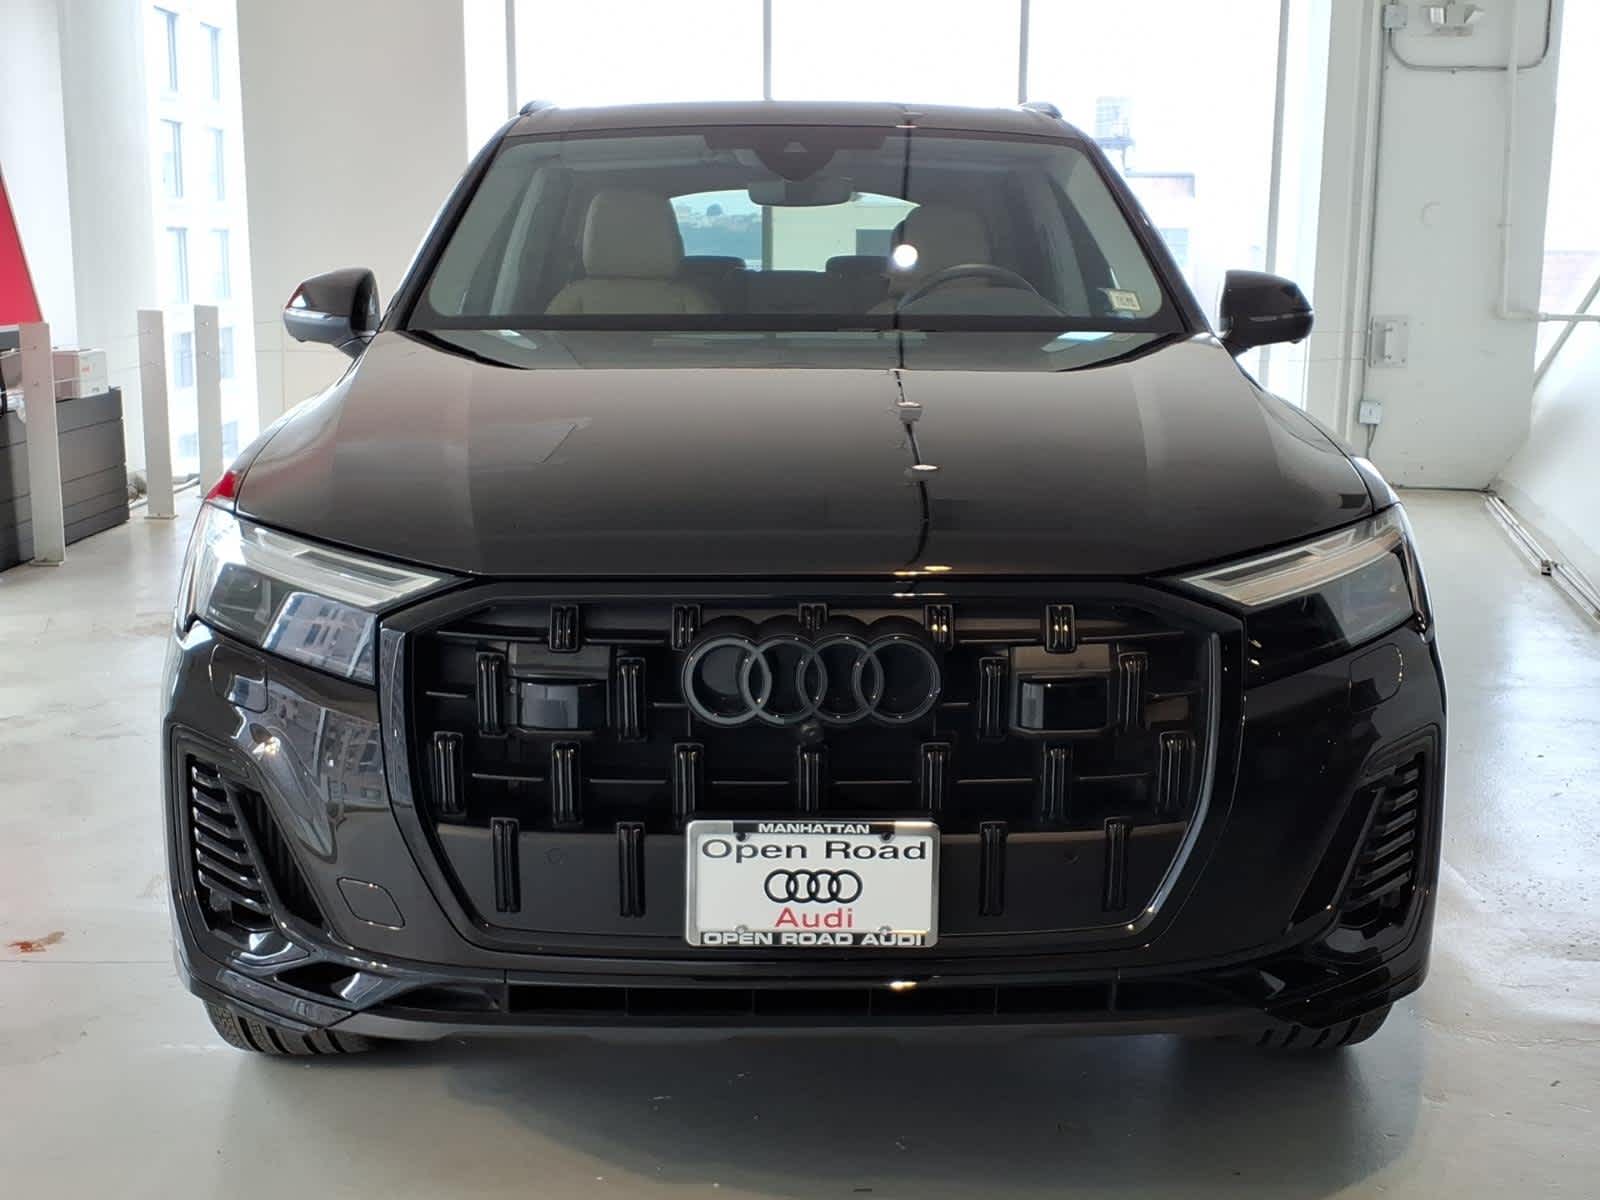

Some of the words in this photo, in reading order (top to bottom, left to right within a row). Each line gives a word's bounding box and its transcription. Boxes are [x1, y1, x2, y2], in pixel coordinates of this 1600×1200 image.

[758, 823, 870, 834] MANHATTAN
[702, 839, 808, 863] Open
[825, 840, 926, 860] Road
[775, 907, 853, 928] Audi
[703, 932, 773, 945] OPEN
[781, 932, 853, 945] ROAD
[860, 932, 922, 946] AUDI
